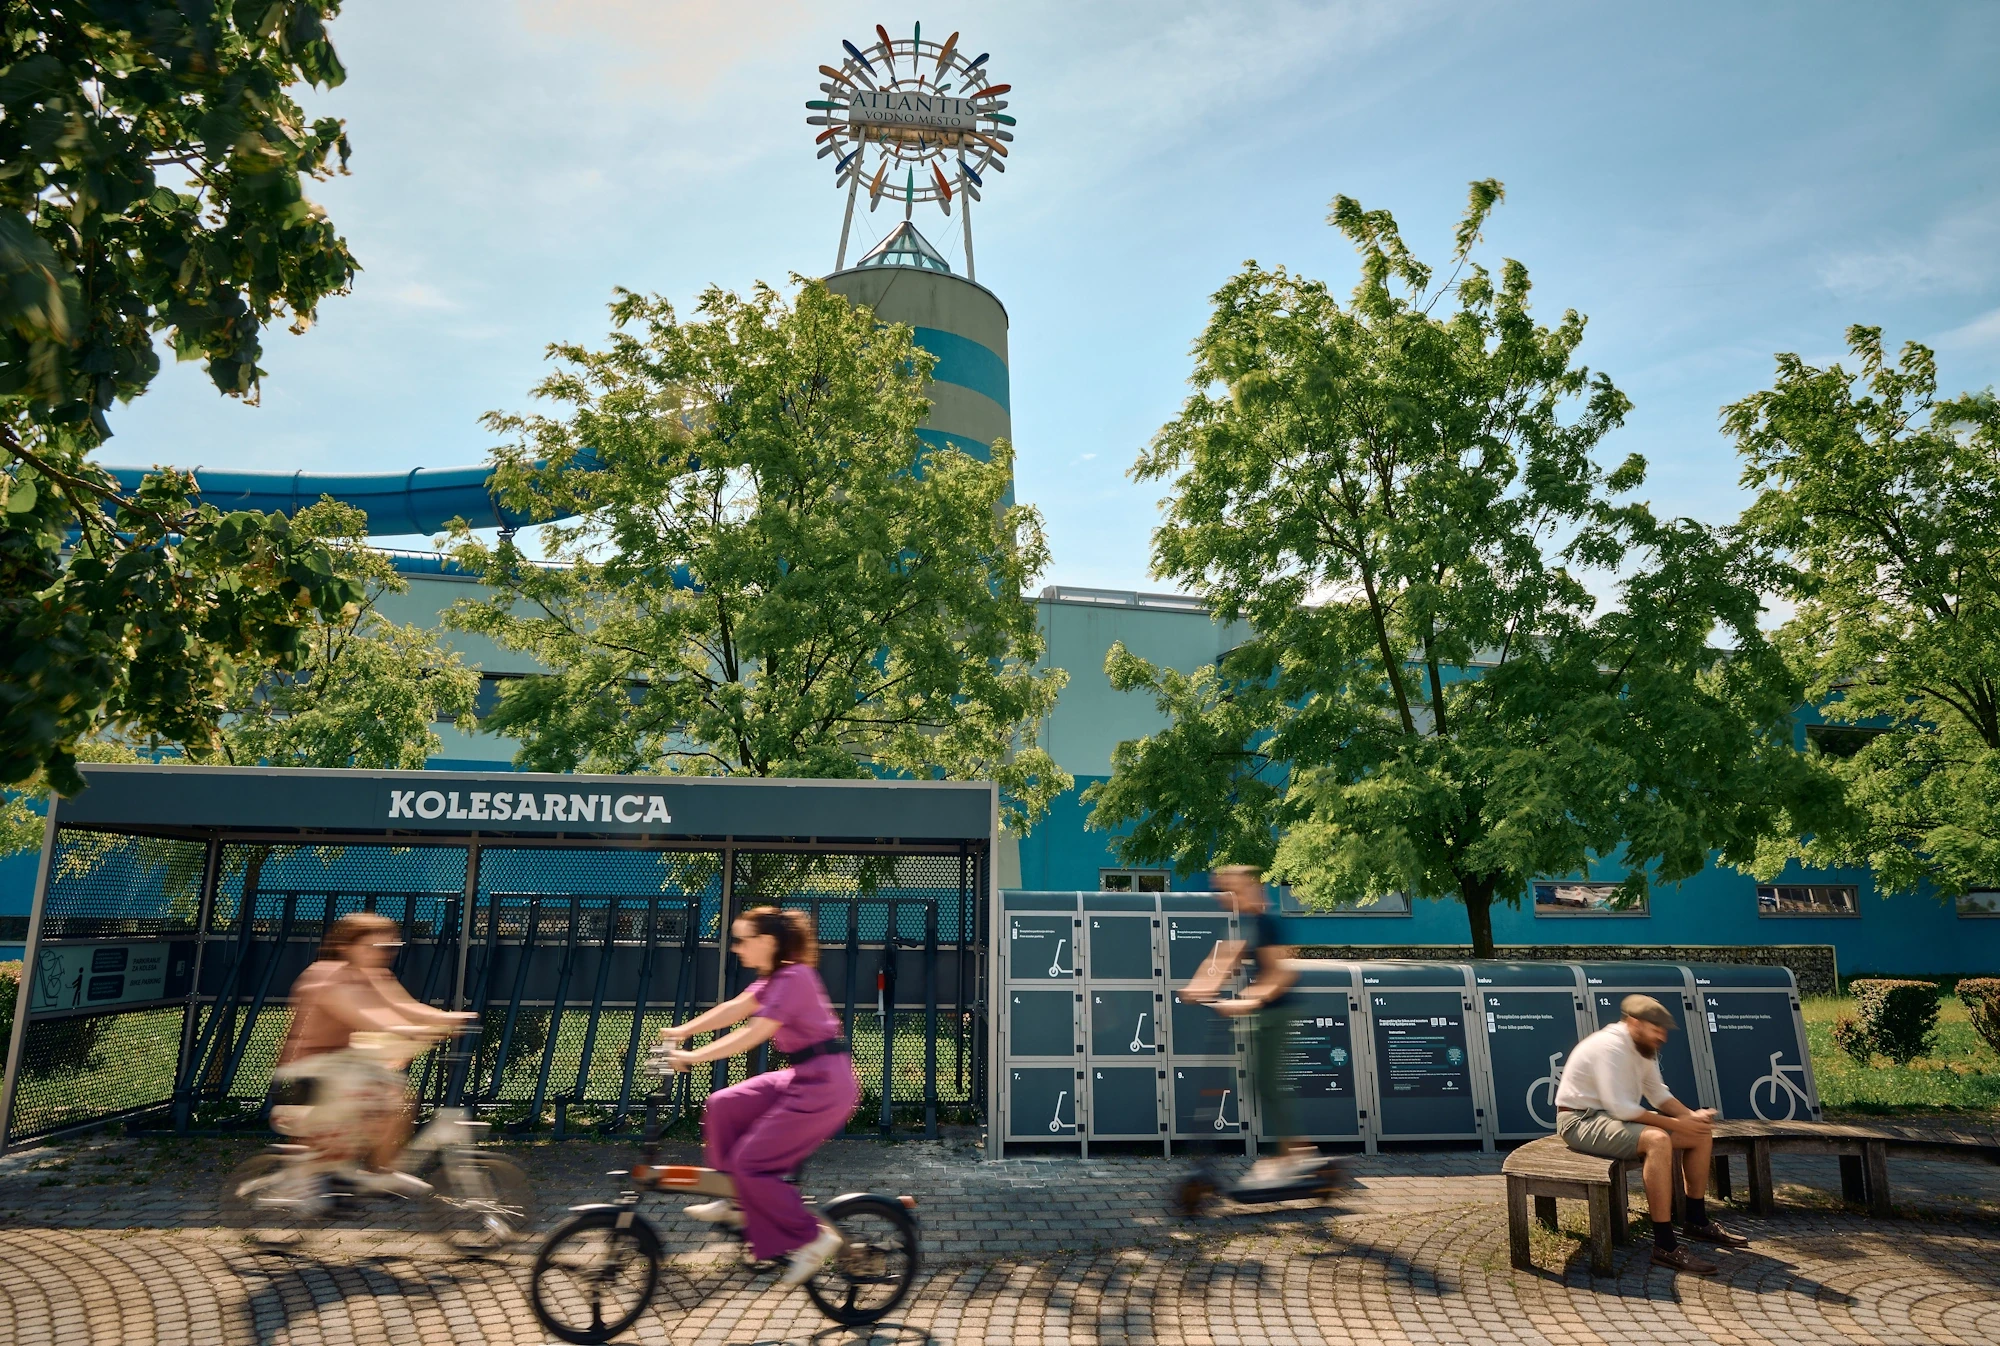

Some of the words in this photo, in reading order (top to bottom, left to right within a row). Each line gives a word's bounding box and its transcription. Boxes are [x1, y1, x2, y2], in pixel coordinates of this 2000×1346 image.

[851, 92, 975, 116] ATLANTIS
[865, 111, 914, 123] VODNO
[918, 115, 961, 127] MESTO
[388, 790, 672, 824] KOLESARNICA
[1014, 920, 1021, 928] 1.
[1171, 921, 1179, 929] 3.
[141, 977, 162, 985] PARKING
[1014, 996, 1021, 1004] 4.
[1375, 998, 1387, 1006] 11.
[1489, 998, 1501, 1006] 12.
[1600, 998, 1611, 1006] 13.
[1707, 998, 1719, 1006] 14.
[1014, 1072, 1021, 1080] 7.
